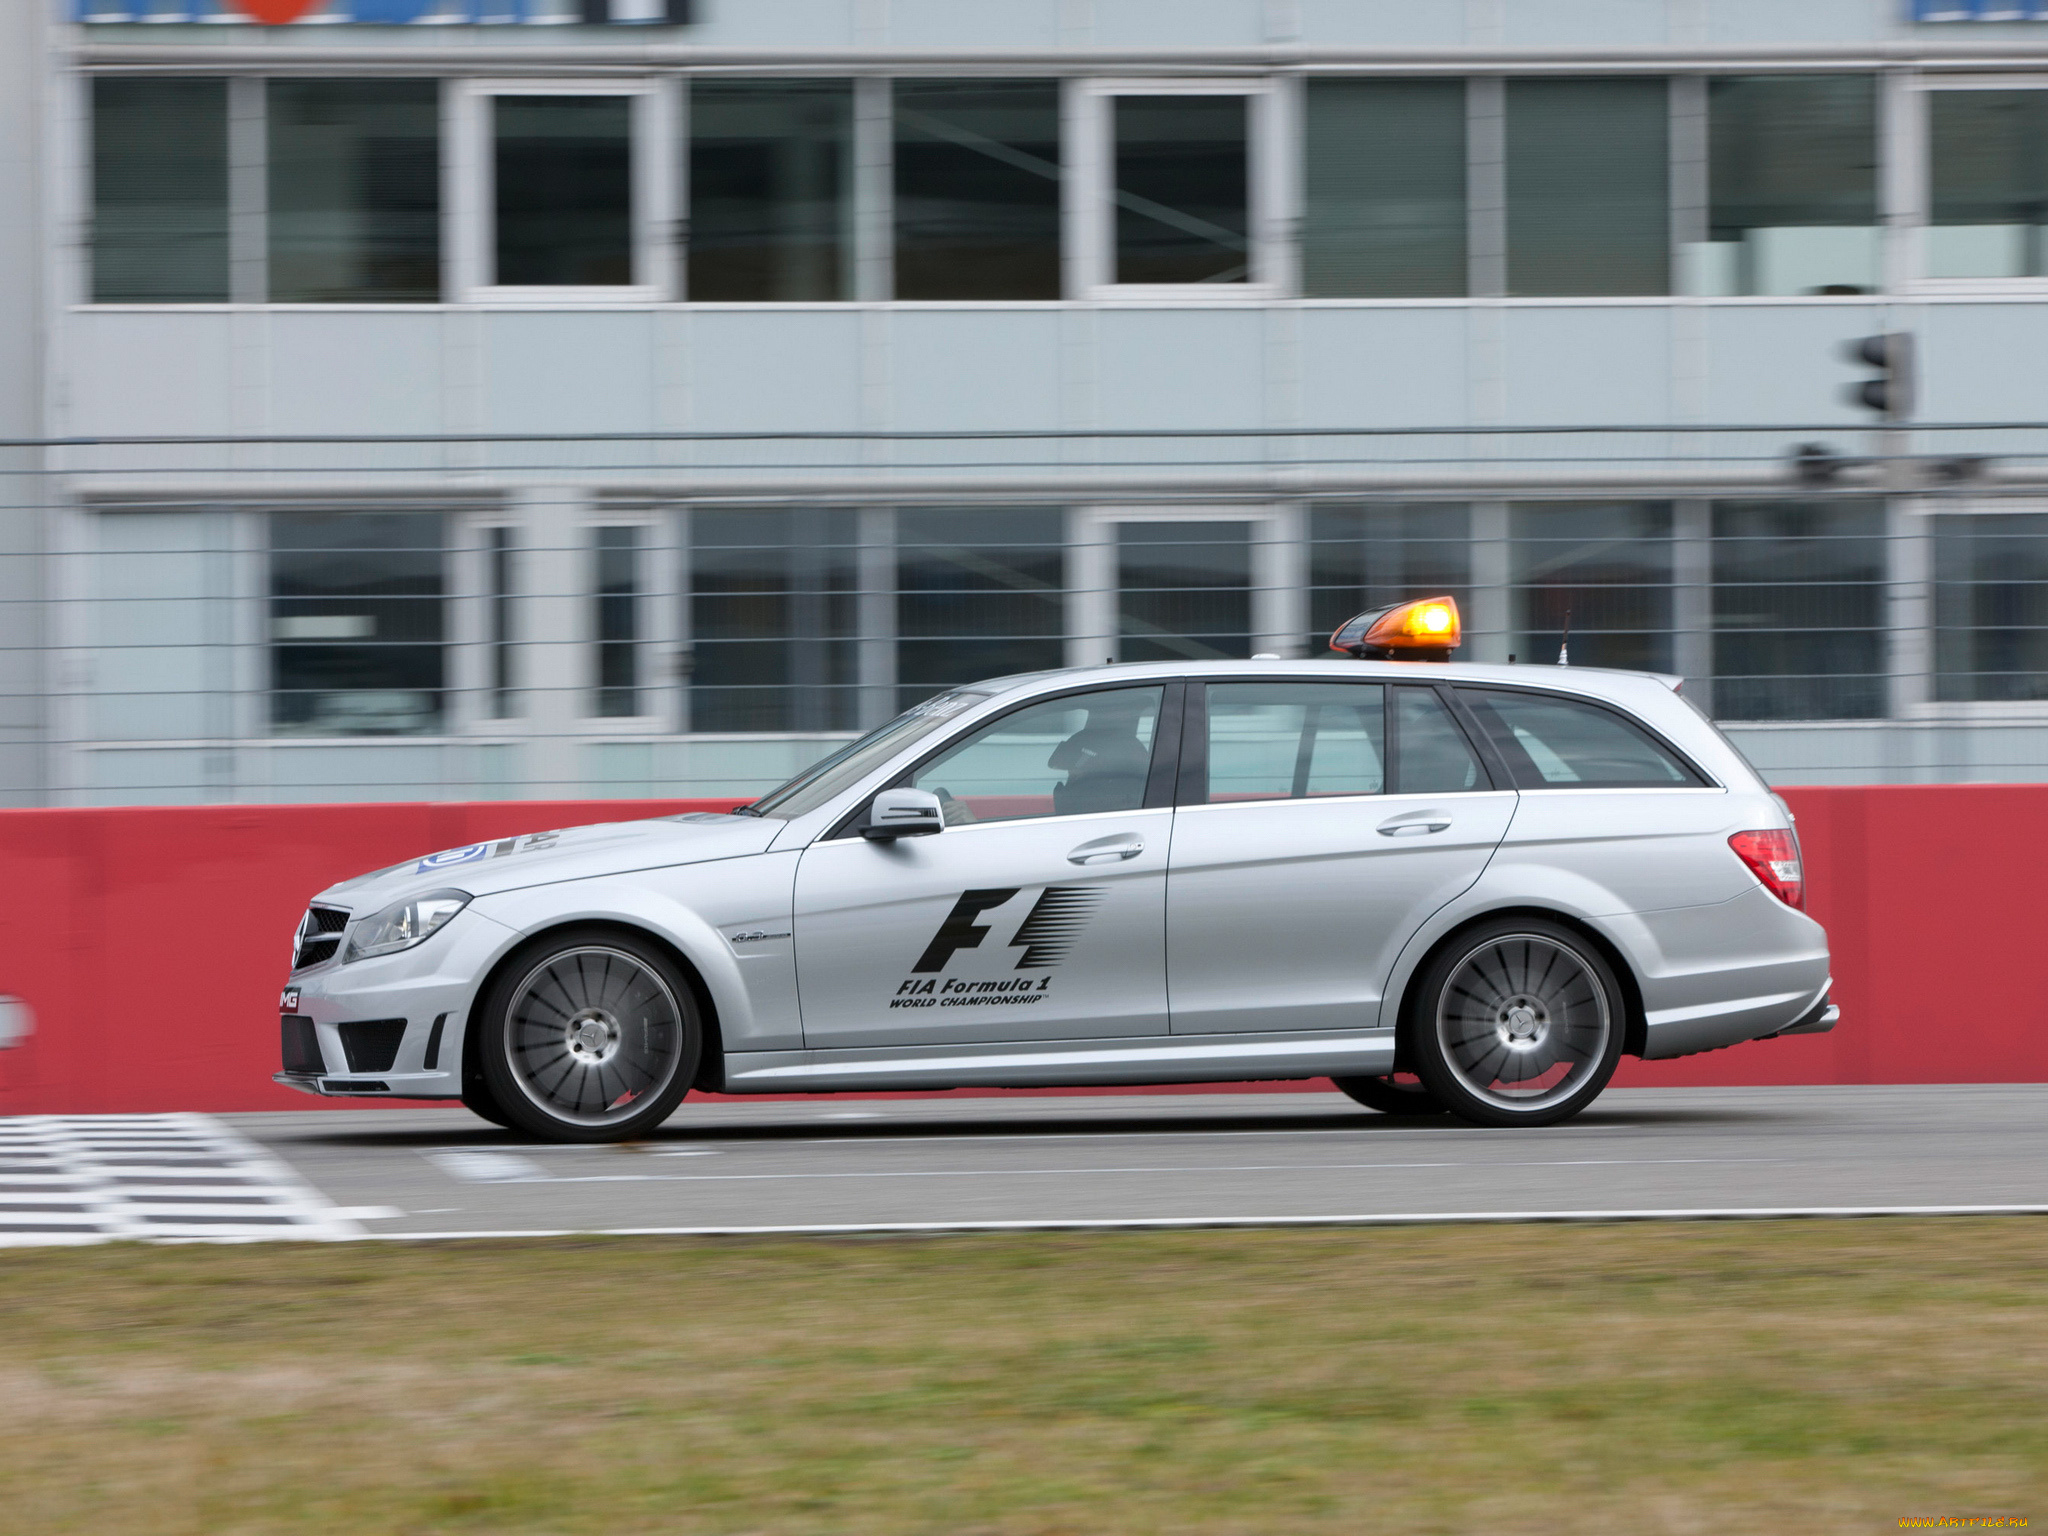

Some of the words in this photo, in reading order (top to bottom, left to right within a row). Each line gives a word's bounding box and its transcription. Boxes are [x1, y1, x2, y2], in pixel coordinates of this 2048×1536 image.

[910, 886, 1113, 974] F1
[896, 979, 937, 996] FIA
[940, 977, 1034, 994] Formula
[1036, 975, 1052, 991] 1
[279, 991, 299, 1008] MG
[889, 998, 936, 1009] WORLD
